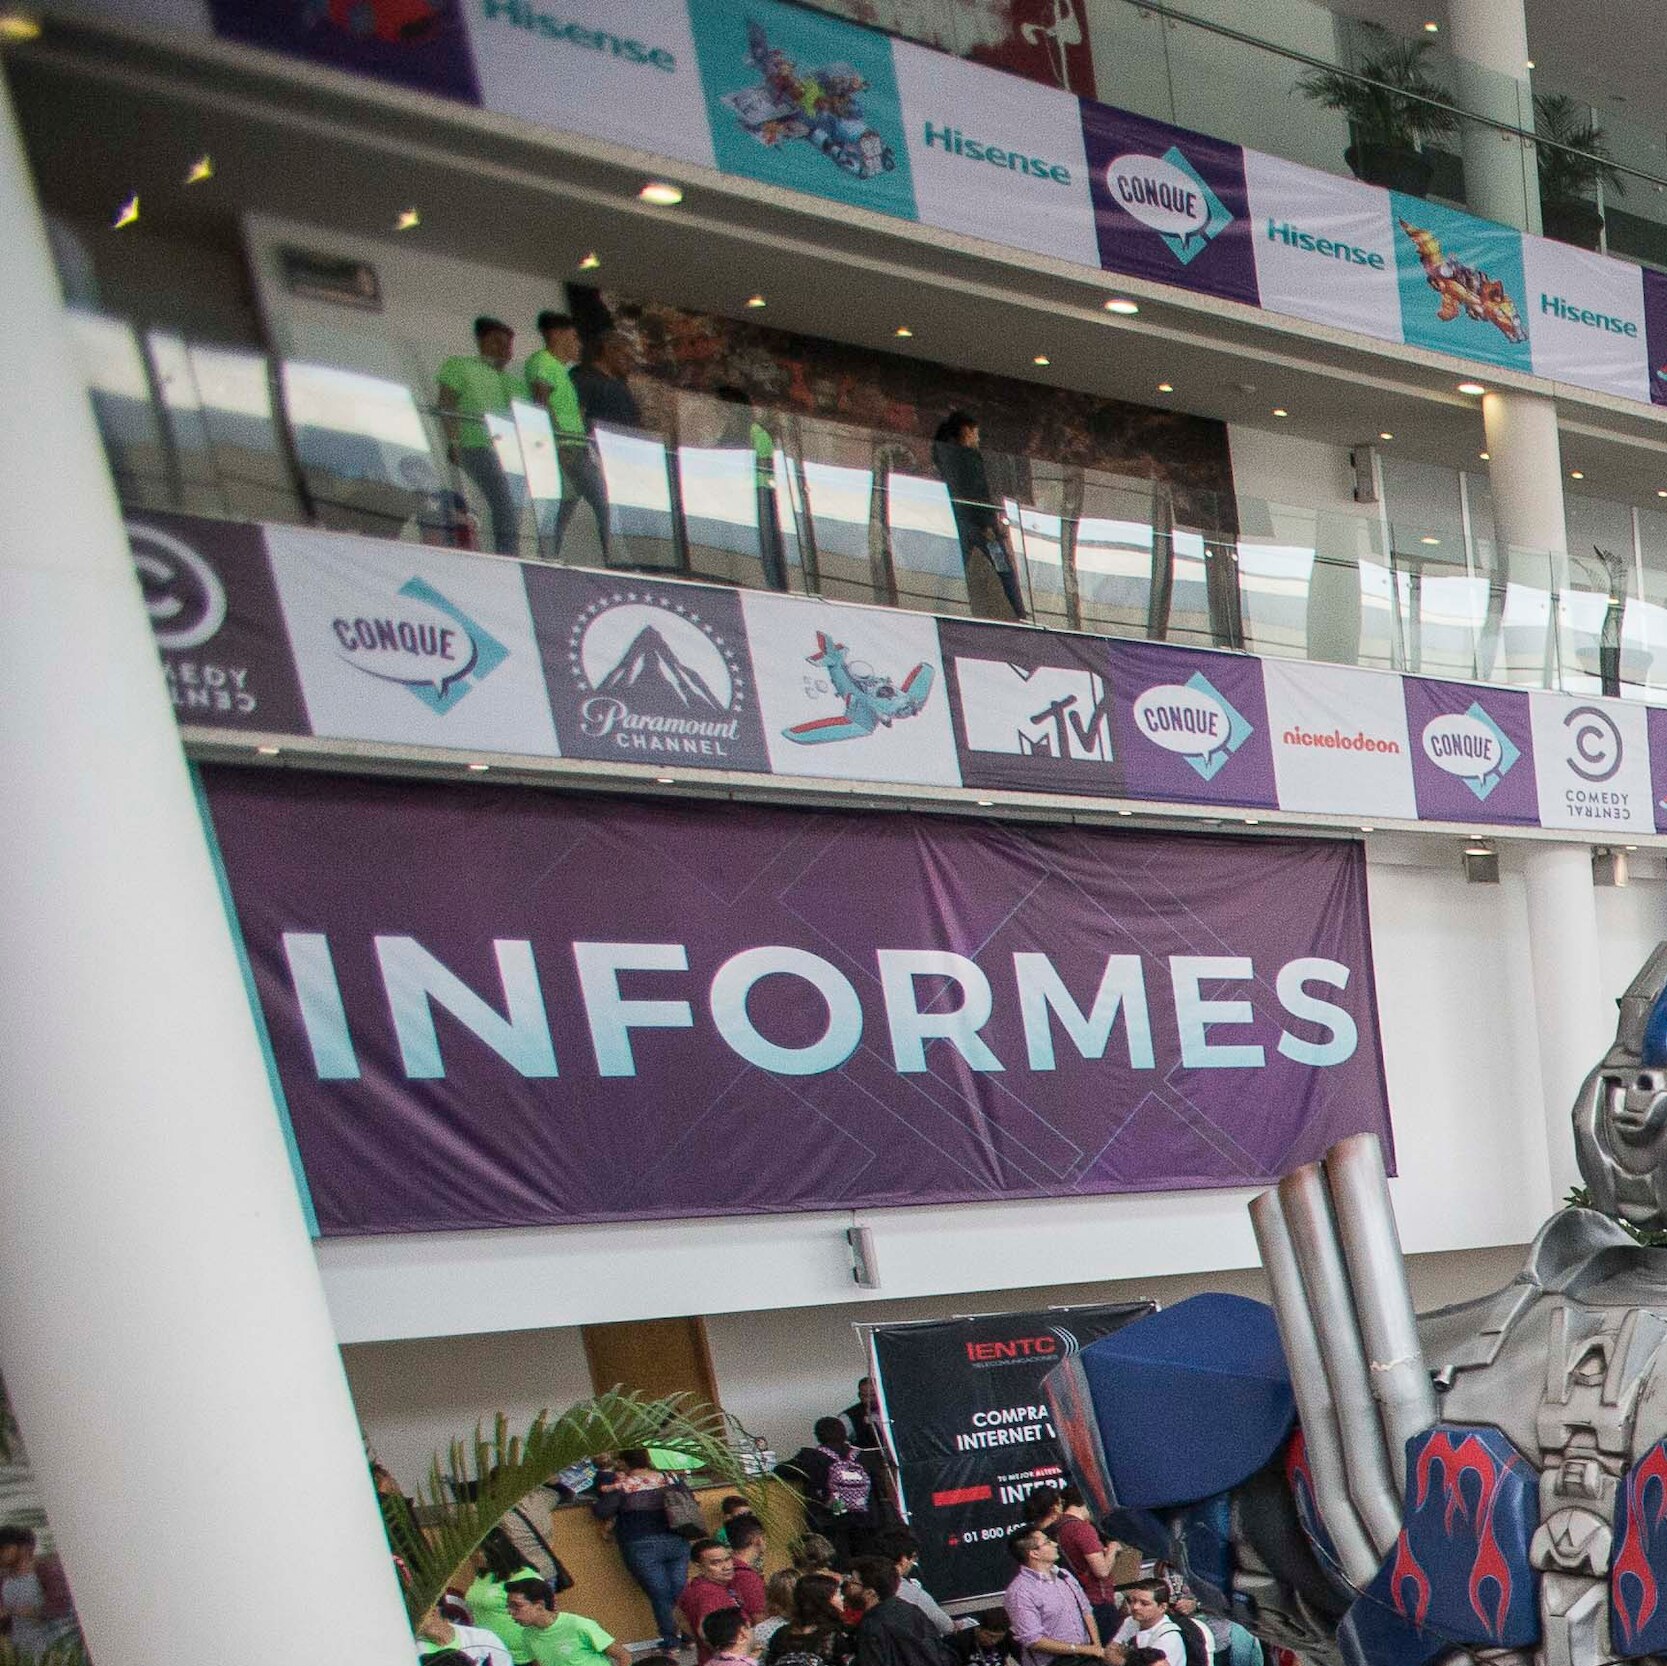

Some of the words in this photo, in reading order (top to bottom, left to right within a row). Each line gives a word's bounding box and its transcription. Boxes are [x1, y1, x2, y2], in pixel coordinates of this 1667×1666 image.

[484, 0, 675, 74] Hisense
[923, 120, 1072, 188] Hisense
[1117, 174, 1198, 220] CONQUE
[1267, 217, 1386, 271] Hisense
[1541, 292, 1638, 339] Hisense
[332, 617, 457, 662] CONQUE
[580, 696, 741, 743] Paramount
[955, 656, 1113, 762] MTV
[1144, 705, 1220, 738] CONQUE
[616, 732, 728, 757] CHANNEL
[1283, 725, 1400, 756] nickelodeon
[1430, 731, 1493, 762] CONQUE
[1565, 788, 1629, 806] COMEDY
[1566, 804, 1631, 821] CENTRAL
[282, 930, 1360, 1080] INFORMES
[972, 1404, 1049, 1428] COMPRA
[956, 1424, 1043, 1451] INTERNET
[963, 1531, 978, 1544] 01
[981, 1526, 1004, 1541] 800
